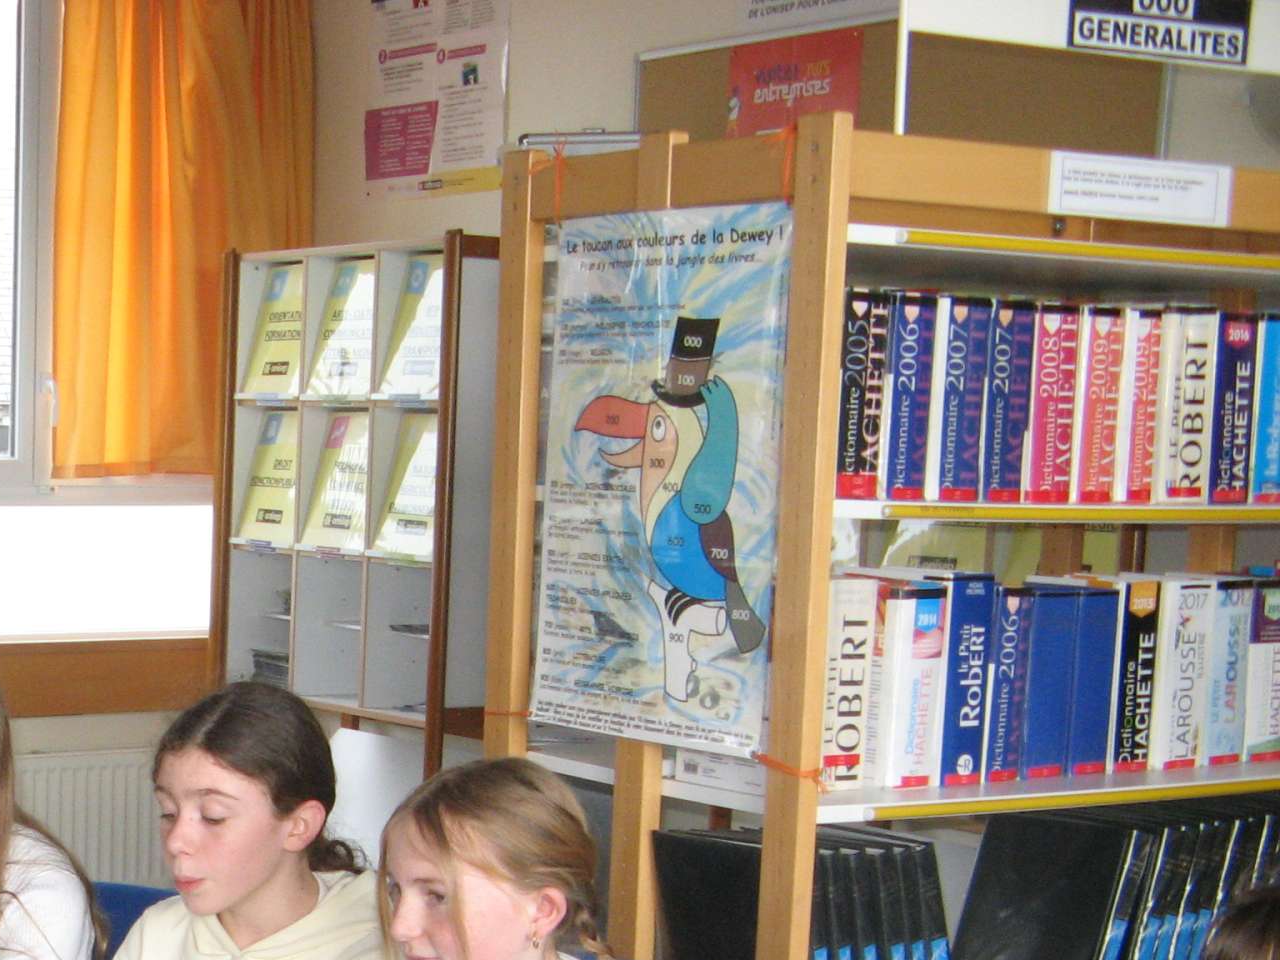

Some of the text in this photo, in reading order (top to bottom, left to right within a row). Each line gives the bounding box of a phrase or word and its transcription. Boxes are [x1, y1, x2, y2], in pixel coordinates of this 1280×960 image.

[1078, 17, 1240, 58] GENERALITES
[753, 78, 831, 106] entreprises
[637, 231, 685, 249] couleurs
[691, 229, 707, 246] de
[712, 229, 725, 245] la
[730, 226, 774, 249] Dewey
[676, 252, 706, 270] jungle
[683, 336, 703, 349] 000
[898, 323, 920, 392] 2006
[946, 324, 969, 392] 2007
[992, 328, 1013, 394] 2007
[1039, 336, 1060, 398] 2008
[1091, 338, 1109, 400] 2009
[676, 374, 696, 386] 100
[842, 319, 869, 475] ictionnaire 2005
[1179, 337, 1209, 489] ROBERT
[1231, 360, 1252, 492] HACHETTE
[648, 456, 666, 470] 300
[662, 481, 679, 493] 400
[693, 503, 712, 515] 500
[710, 548, 729, 560] 700
[731, 609, 751, 622] 800
[1178, 592, 1209, 611] 2017
[668, 632, 686, 644] 900
[998, 615, 1020, 680] 2006
[835, 614, 869, 782] ROBERT
[1132, 631, 1156, 763] HACHETTE
[1174, 630, 1197, 760] LAROUSSE
[1224, 614, 1241, 725] LAROUSSE
[1118, 660, 1137, 763] Dictionnaire
